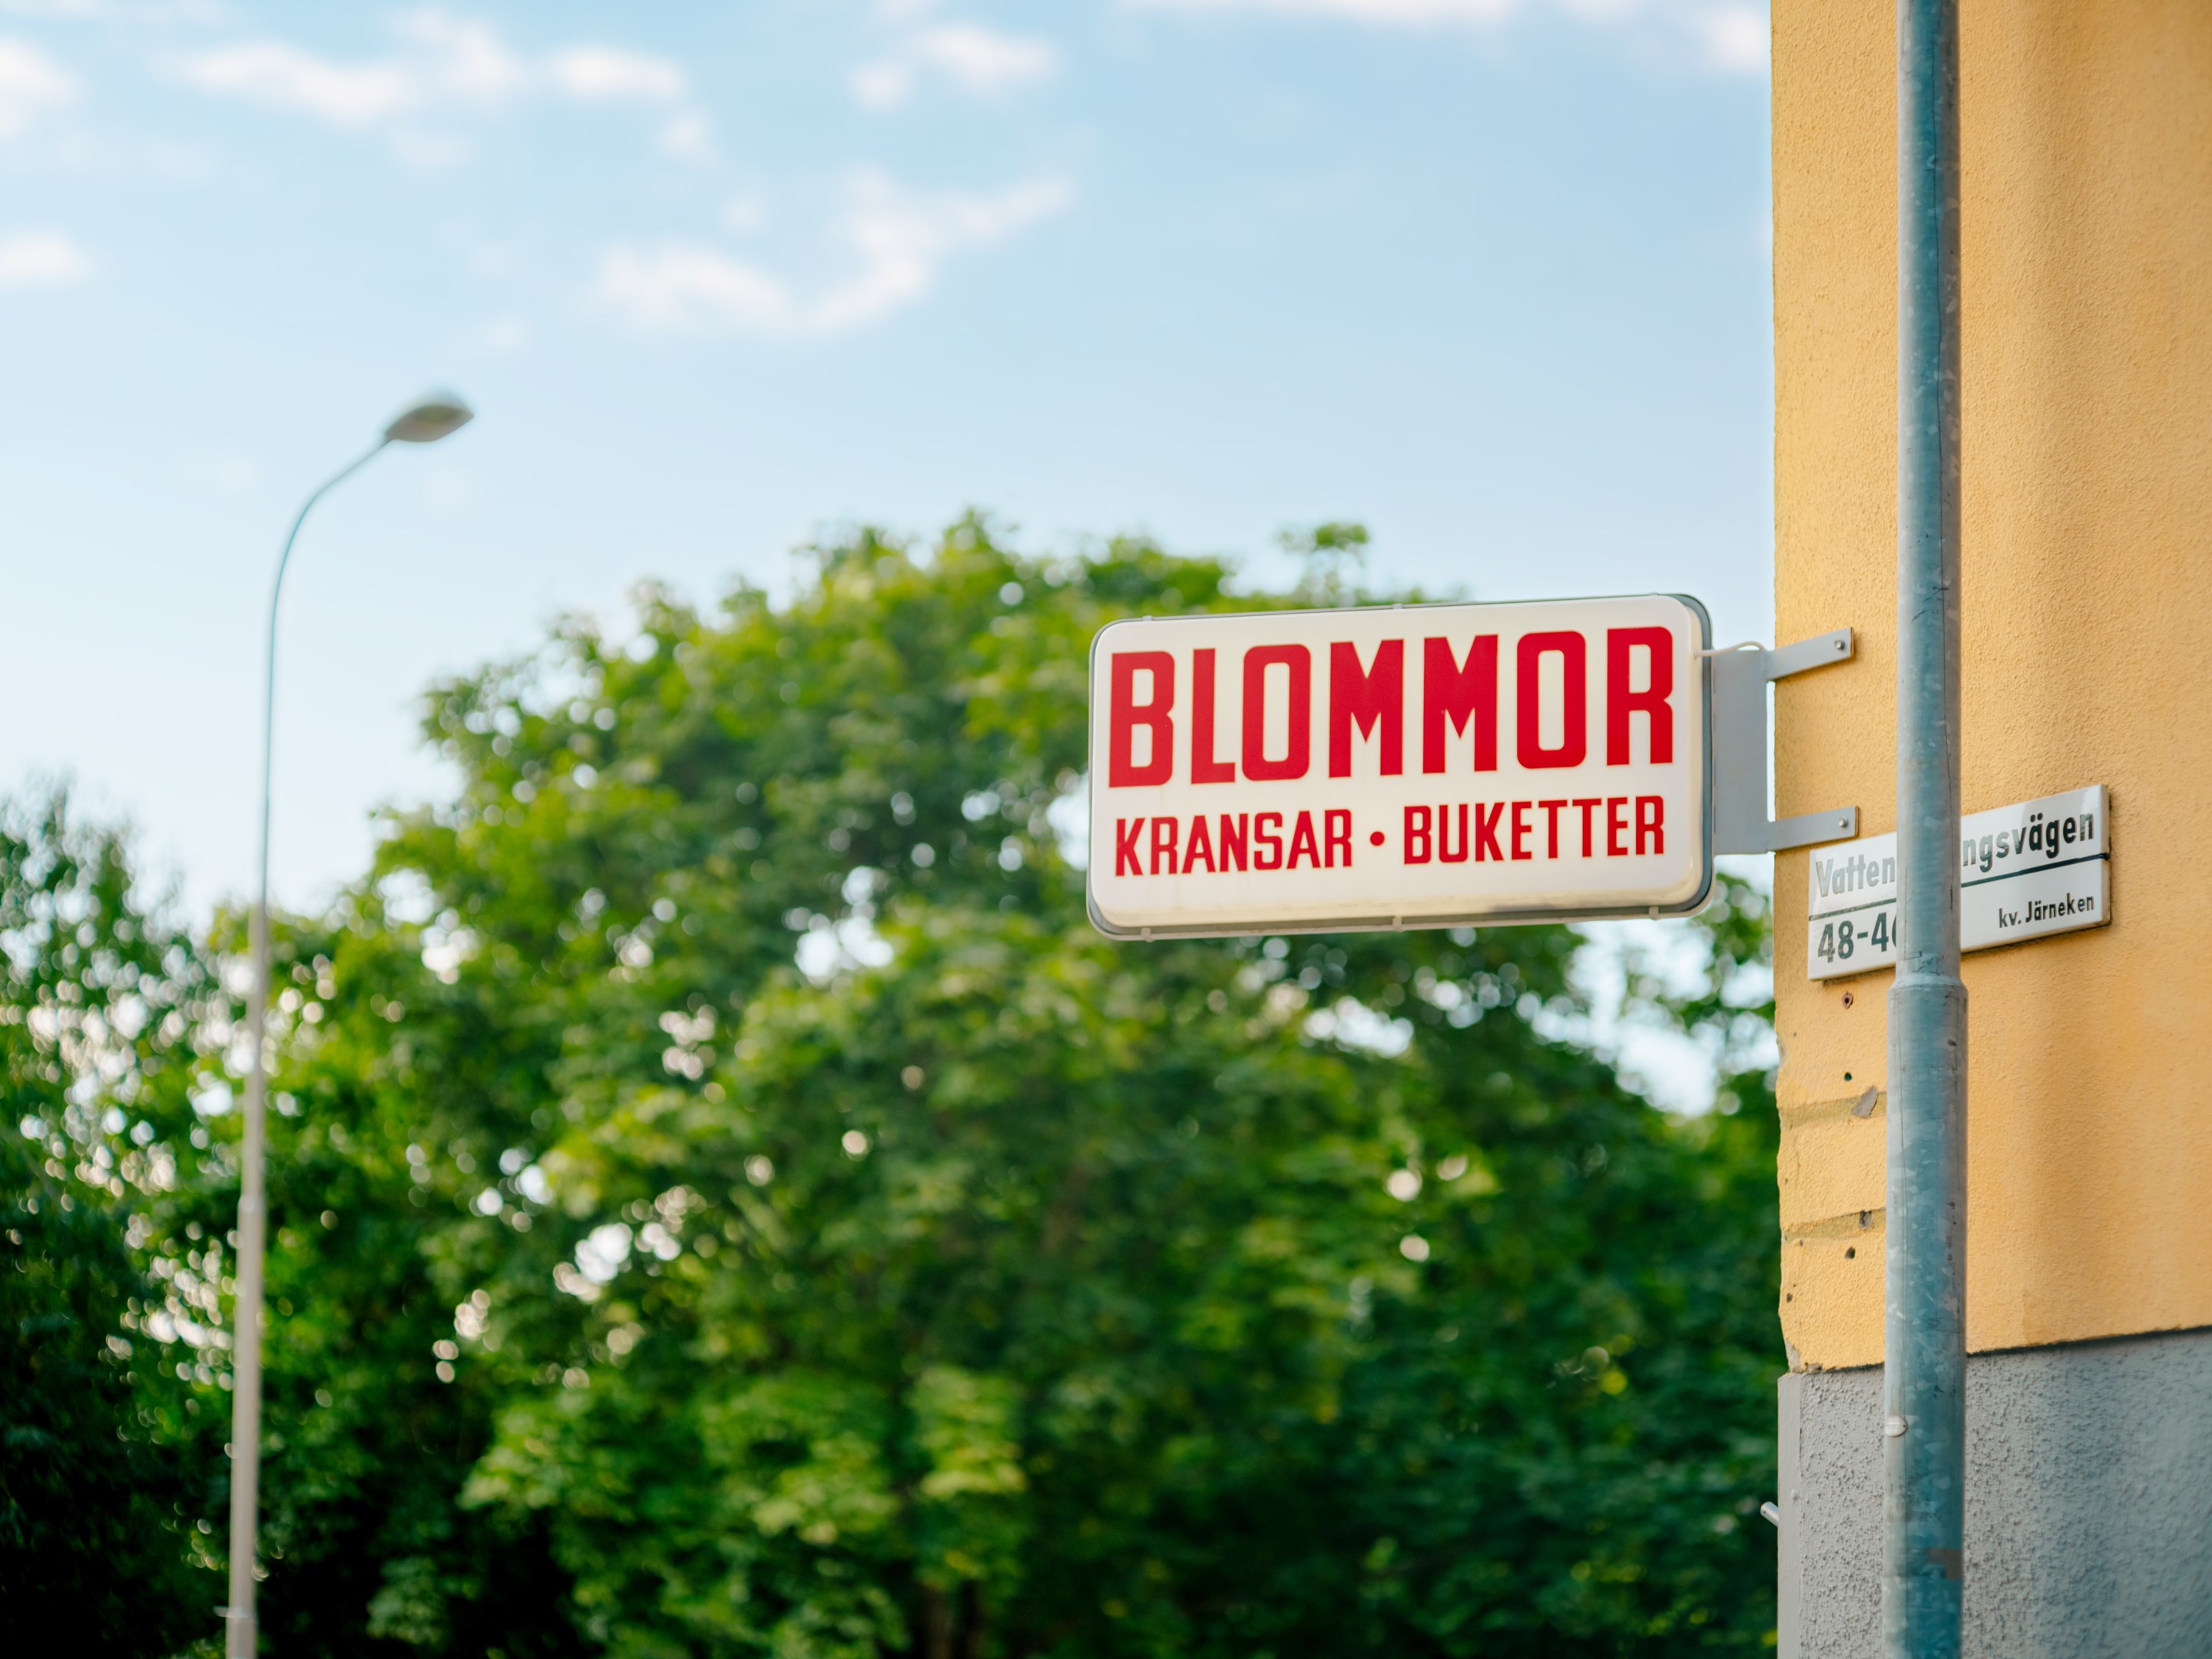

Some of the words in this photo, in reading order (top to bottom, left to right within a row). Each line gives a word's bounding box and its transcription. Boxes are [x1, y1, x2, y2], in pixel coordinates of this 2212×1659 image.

[1108, 626, 1674, 788] BLOMMOR
[1115, 808, 1353, 877] KRANSAR
[1403, 795, 1664, 865] BUKETTER
[1817, 912, 1897, 963] 48-4
[1998, 907, 2022, 929] kv.
[2025, 892, 2095, 923] Järneken
